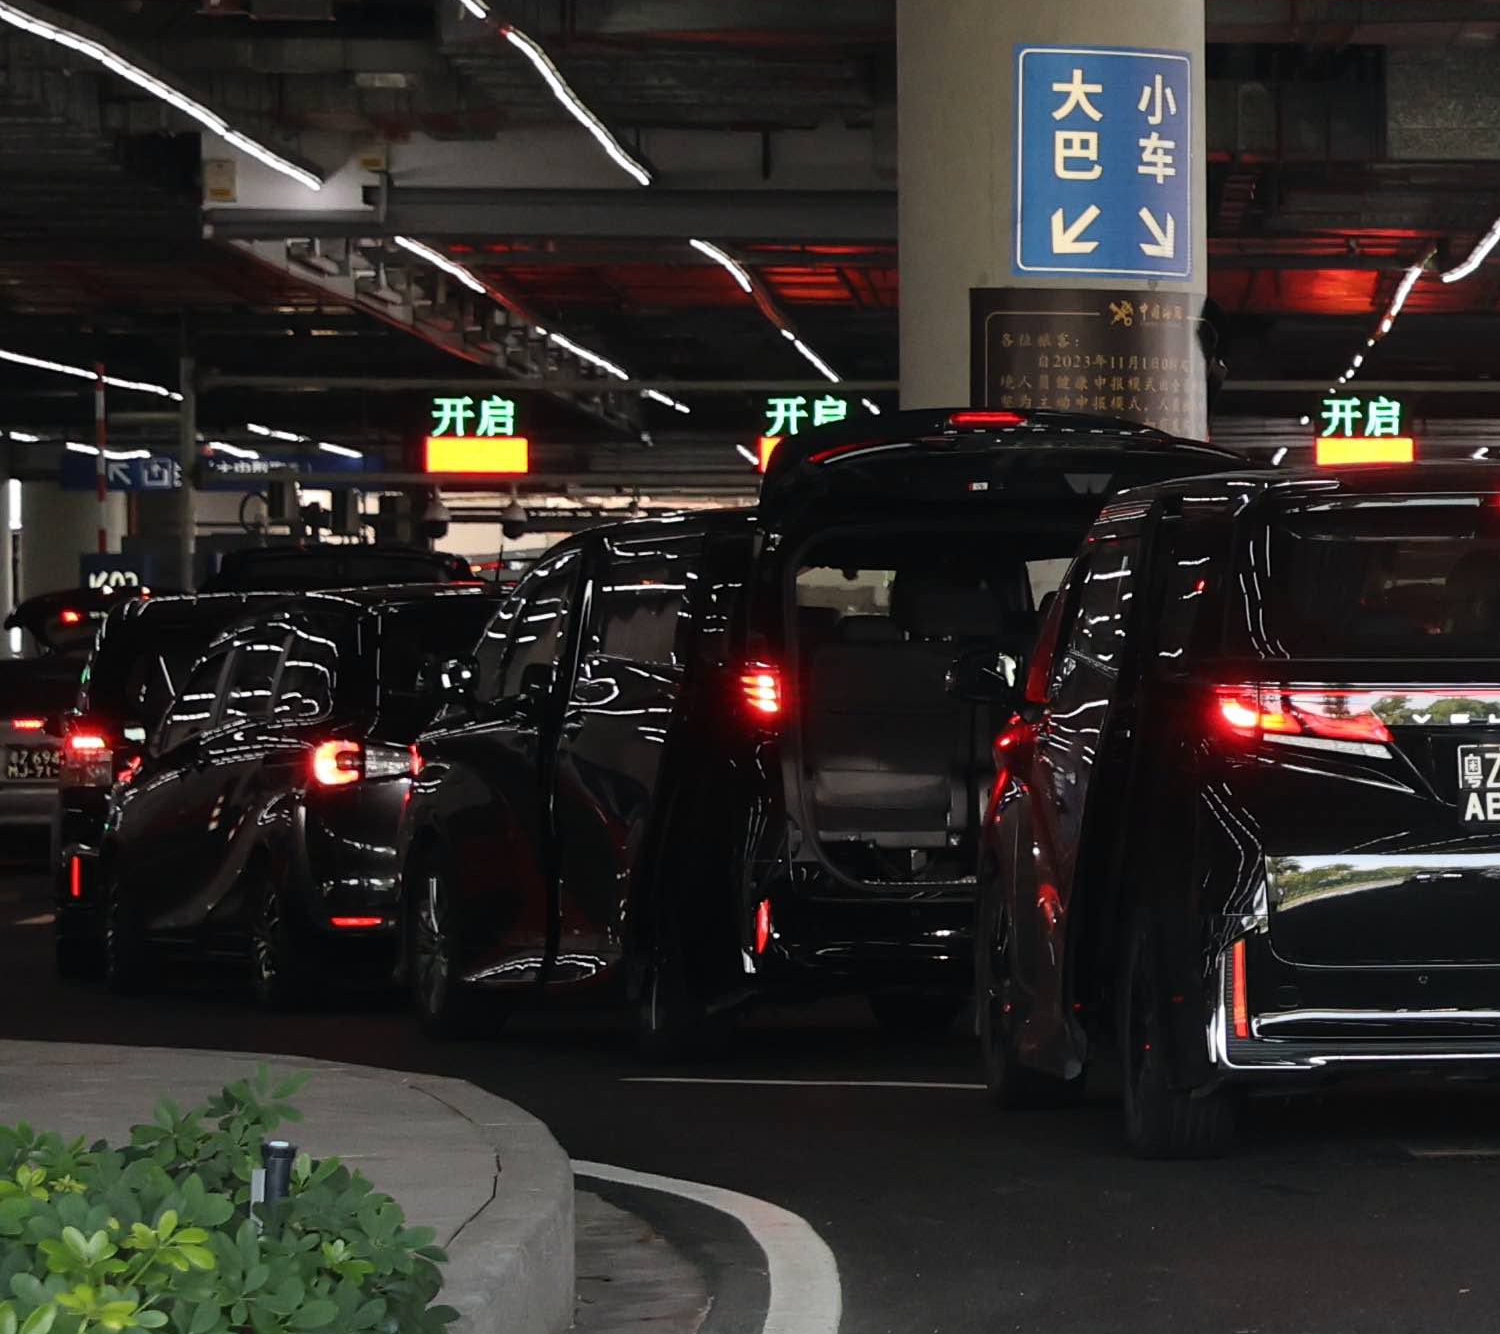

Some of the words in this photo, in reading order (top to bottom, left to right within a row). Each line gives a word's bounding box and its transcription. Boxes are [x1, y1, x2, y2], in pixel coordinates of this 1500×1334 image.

[1051, 69, 1103, 180] 大巴
[1137, 74, 1177, 184] 小车
[431, 396, 515, 437] 开启
[1321, 397, 1401, 438] 开启
